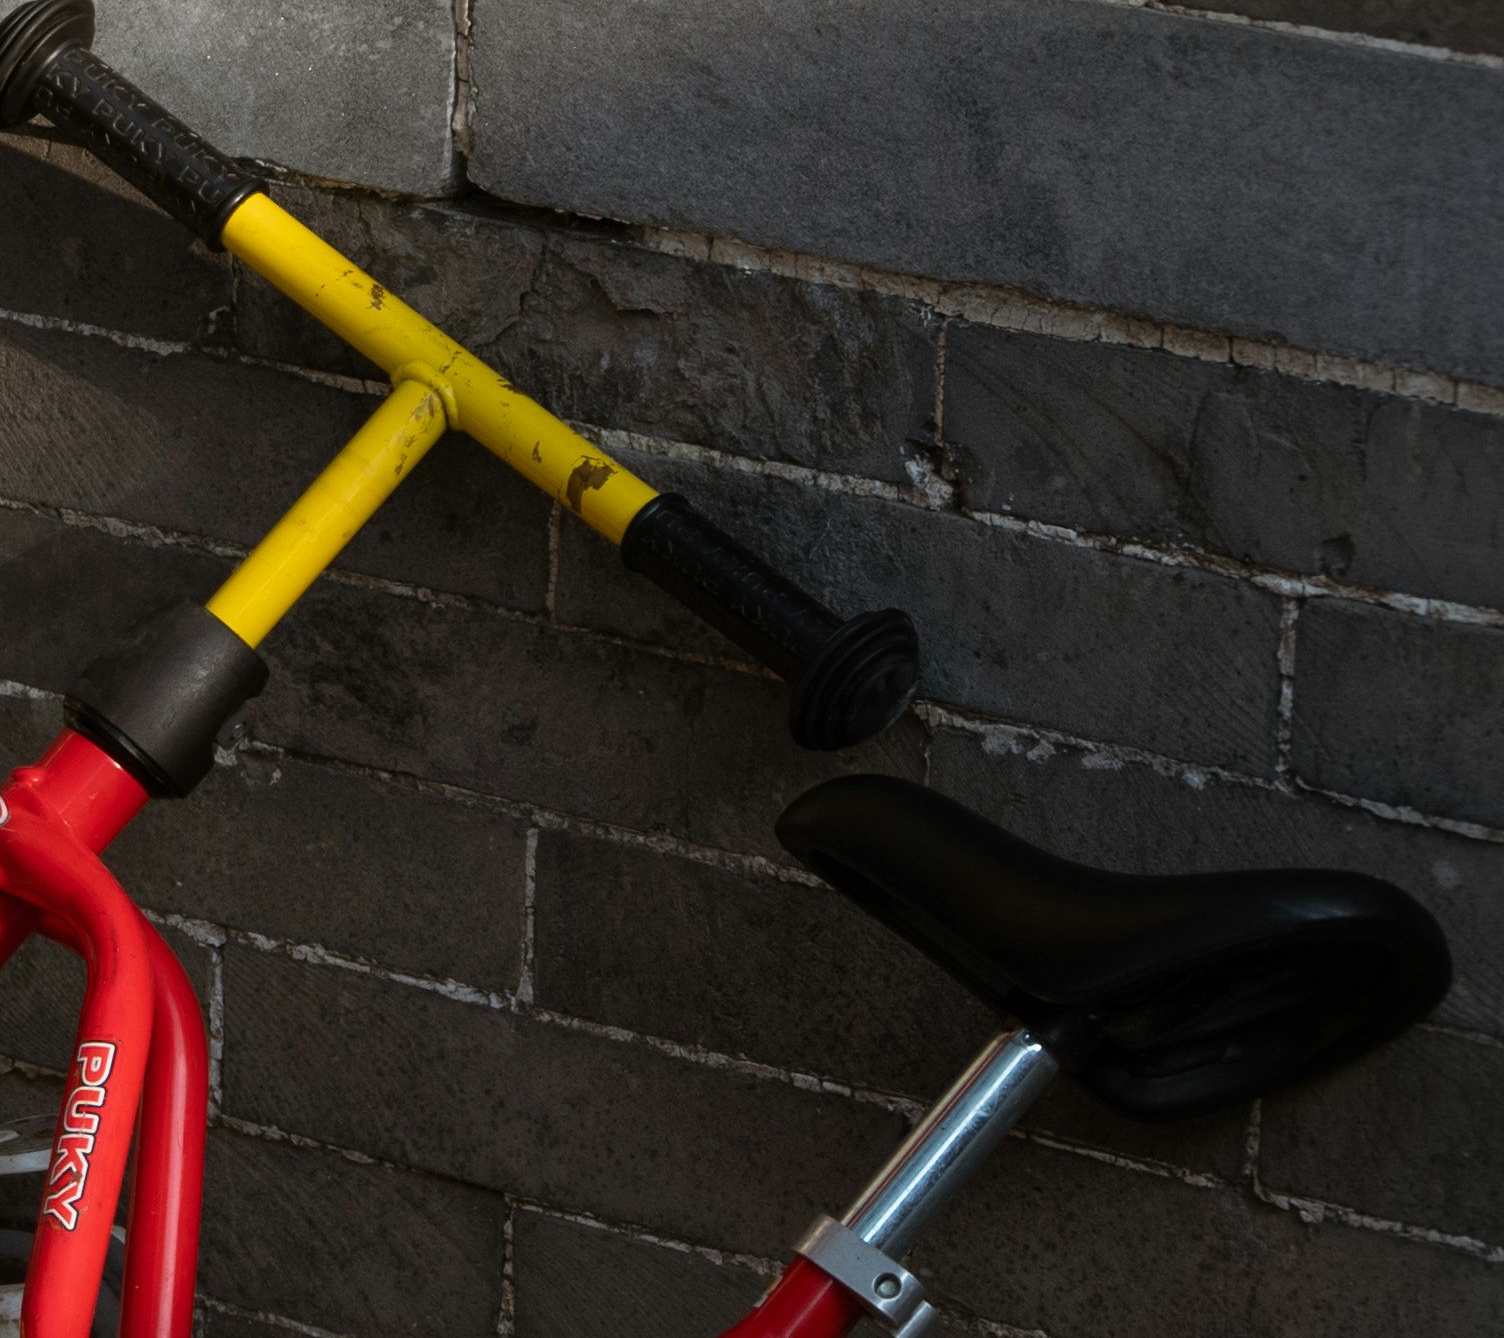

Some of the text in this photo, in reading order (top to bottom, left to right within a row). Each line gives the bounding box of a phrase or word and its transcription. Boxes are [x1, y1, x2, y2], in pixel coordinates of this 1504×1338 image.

[63, 47, 147, 109] PUKY
[151, 115, 239, 182] PUKY
[91, 98, 177, 166] PUKY
[176, 164, 224, 205] PU
[43, 1041, 116, 1231] PUKY
